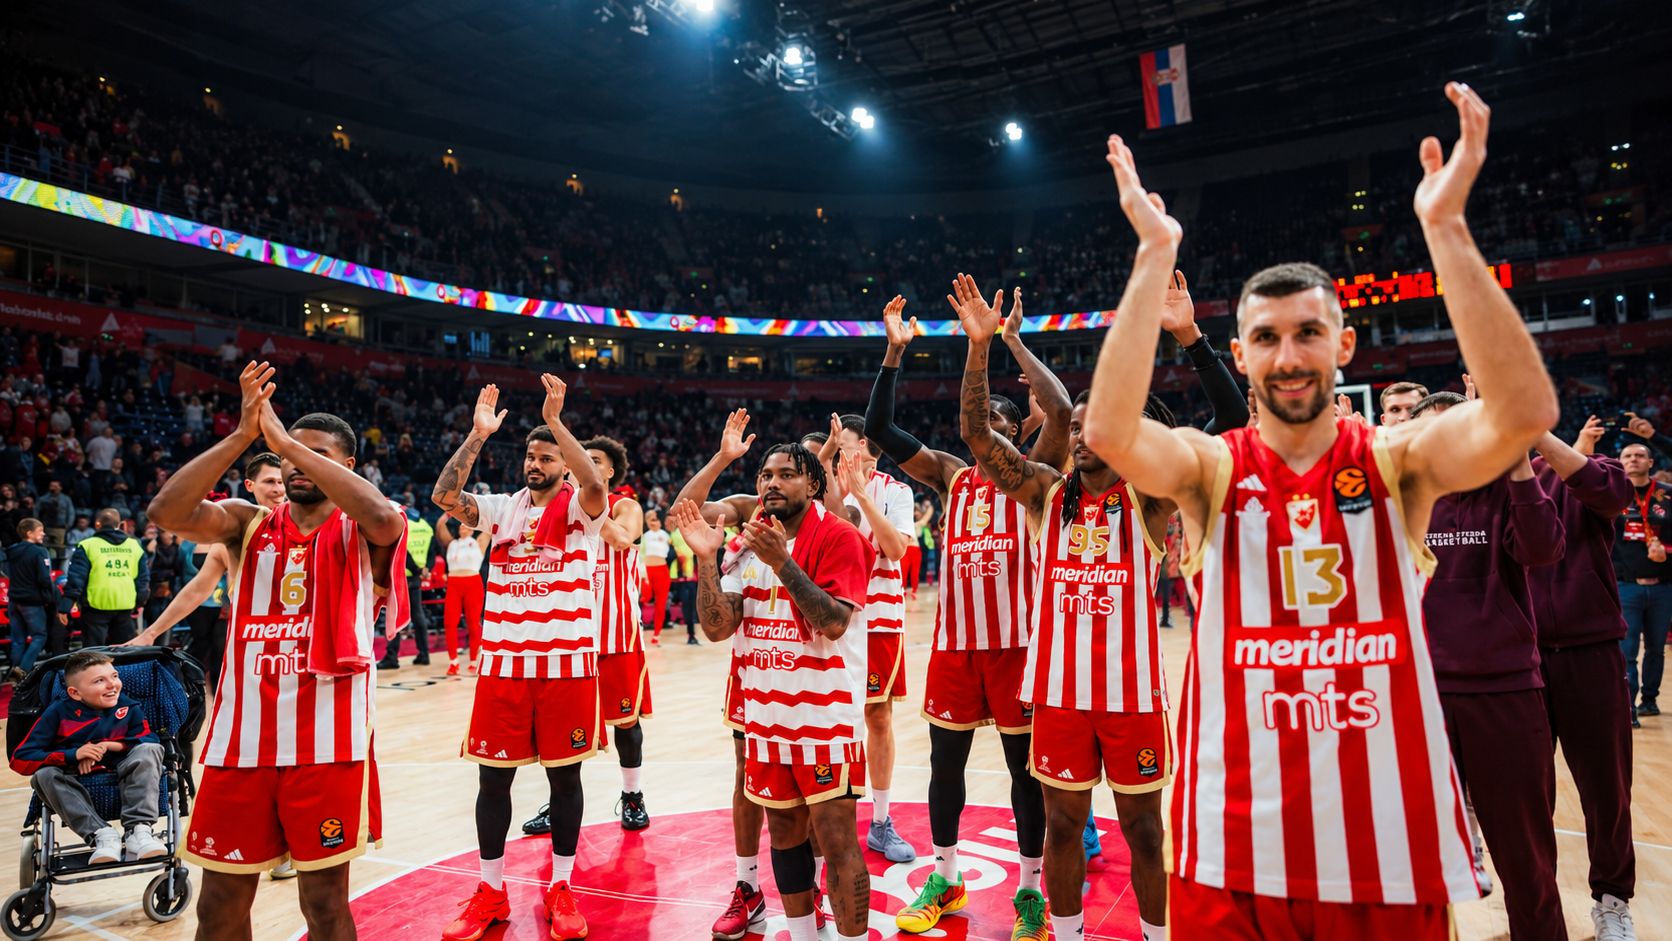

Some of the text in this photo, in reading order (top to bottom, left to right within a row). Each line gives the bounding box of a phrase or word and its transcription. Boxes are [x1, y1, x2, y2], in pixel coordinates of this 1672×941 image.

[966, 503, 991, 531] 15
[951, 535, 1013, 554] meridian
[1069, 524, 1110, 556] 95
[957, 556, 1002, 579] mts
[1051, 564, 1128, 583] meridian
[1278, 544, 1348, 610] 13
[280, 570, 307, 607] 6
[509, 577, 549, 597] mts
[1060, 590, 1115, 616] mts
[242, 615, 313, 639] merid
[752, 646, 796, 671] mts
[1234, 627, 1397, 666] meridian
[255, 648, 306, 675] mt
[1263, 681, 1380, 731] mts
